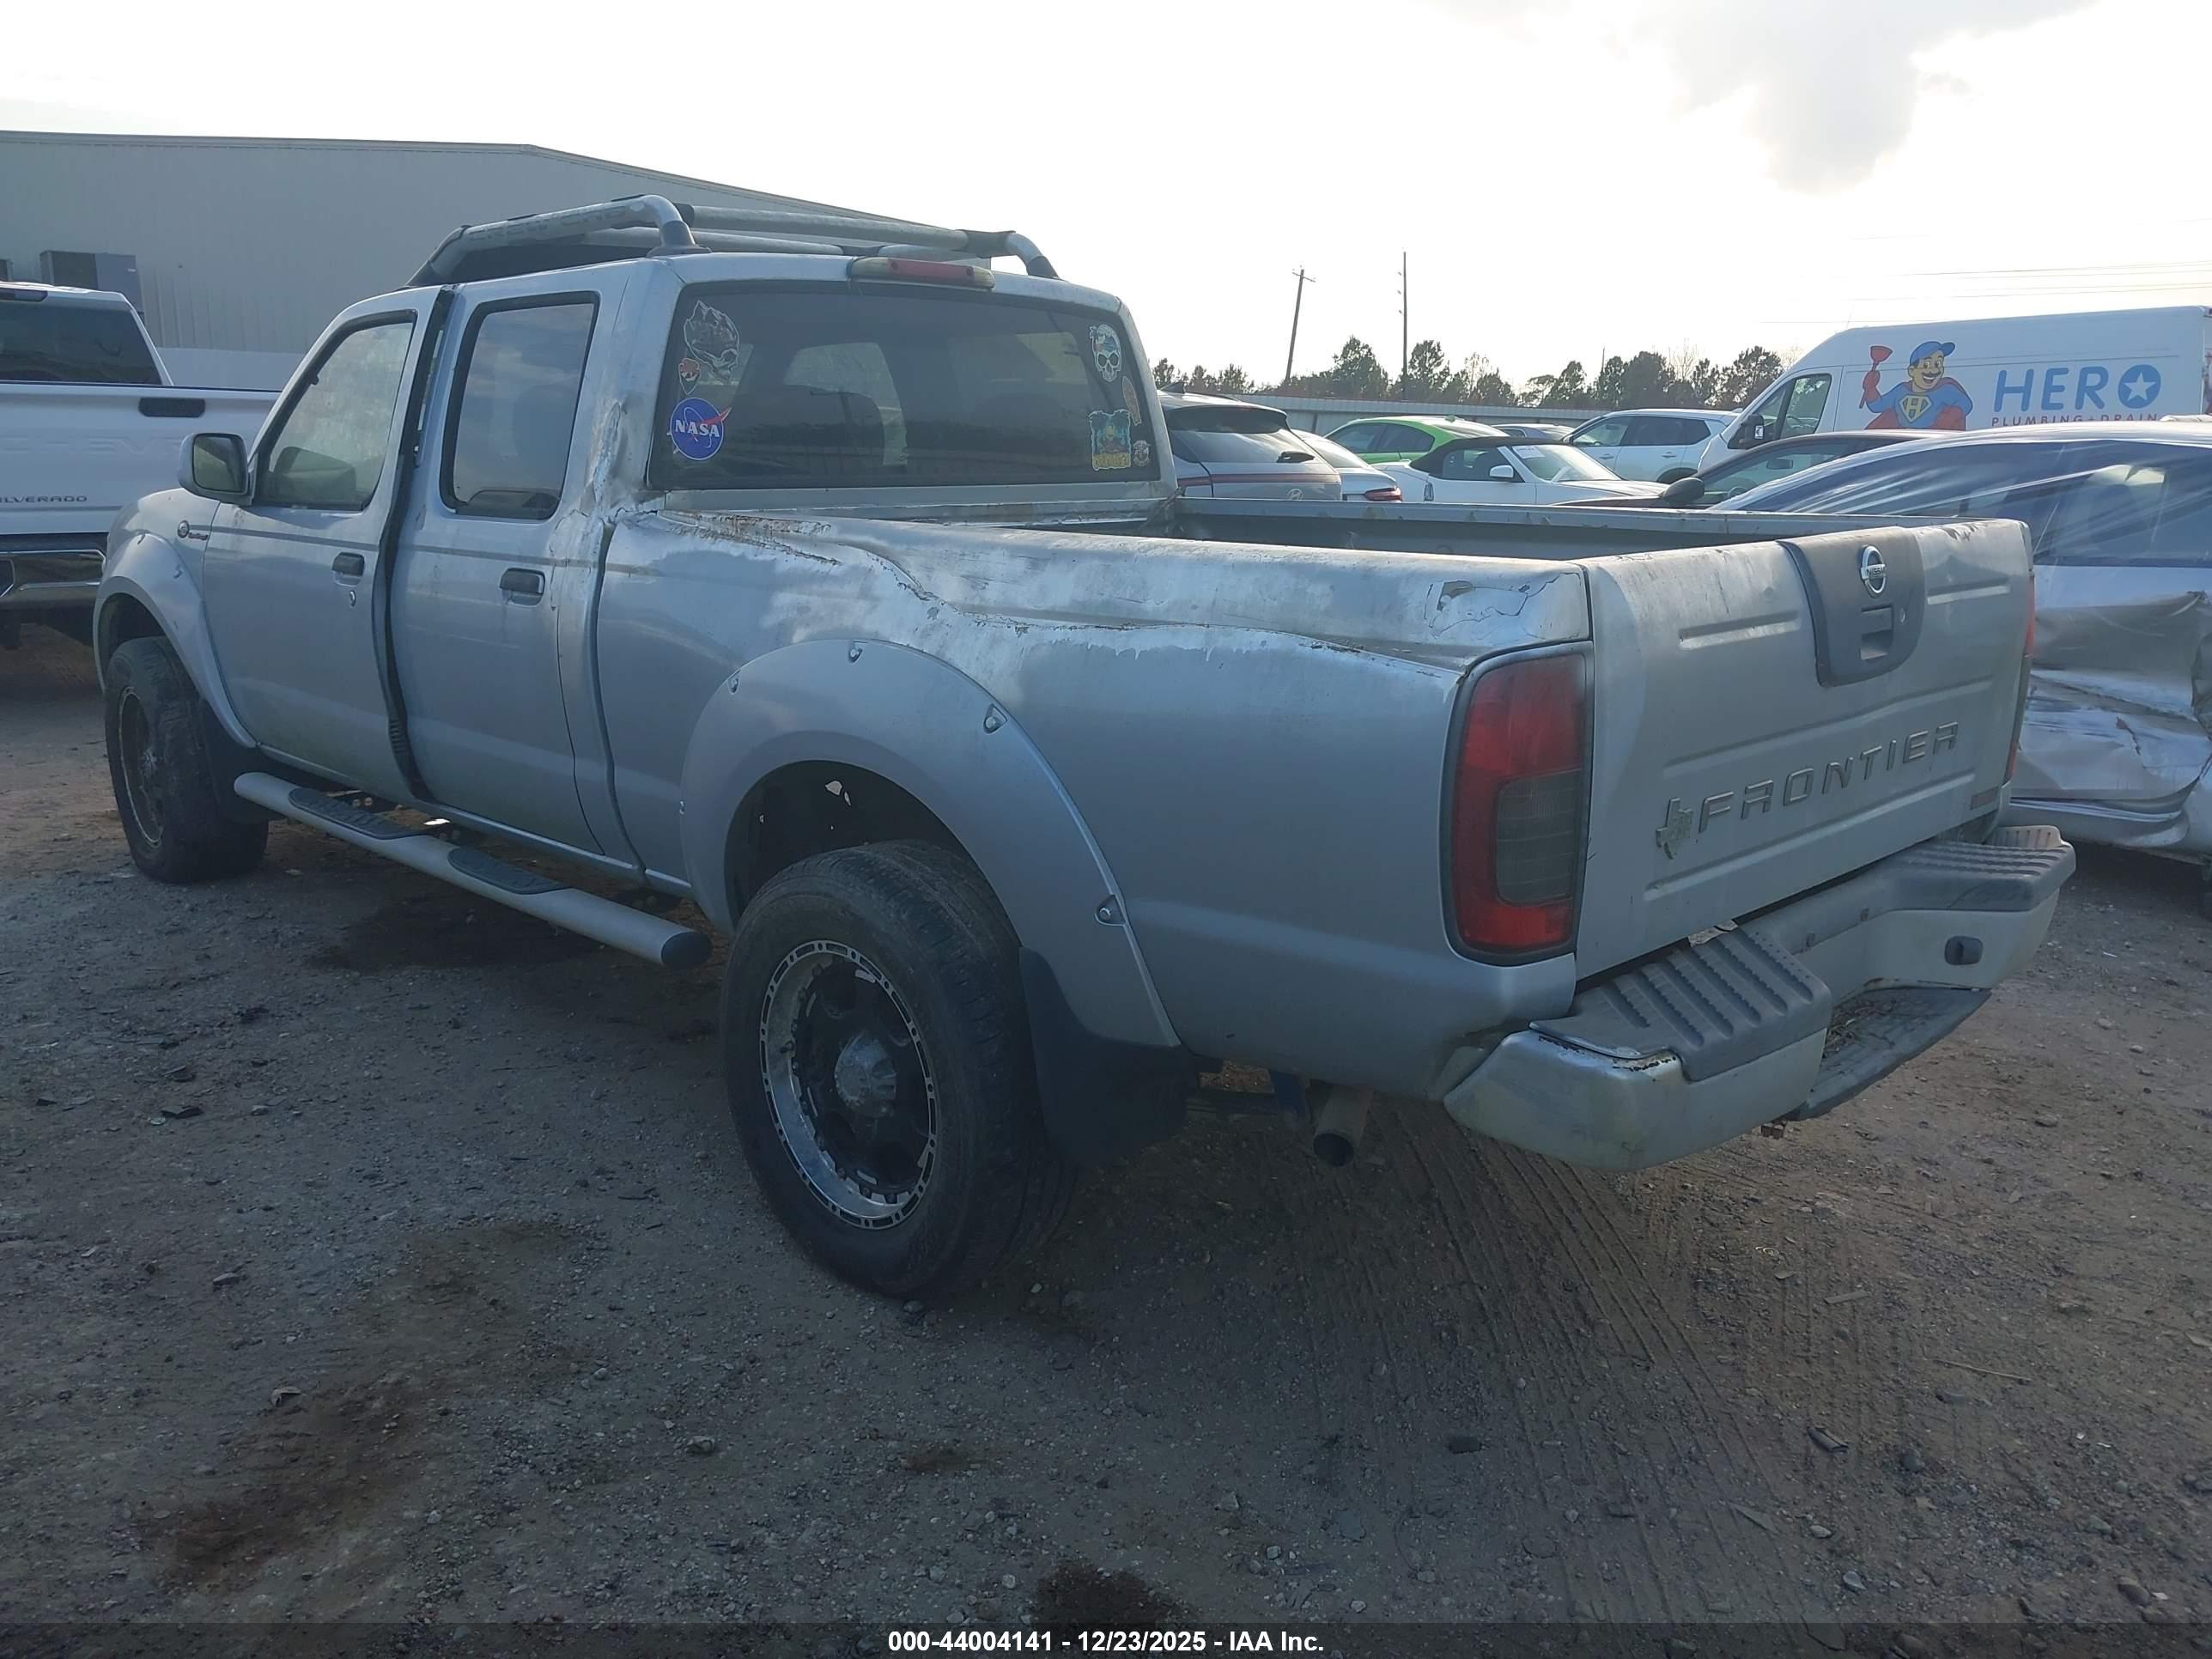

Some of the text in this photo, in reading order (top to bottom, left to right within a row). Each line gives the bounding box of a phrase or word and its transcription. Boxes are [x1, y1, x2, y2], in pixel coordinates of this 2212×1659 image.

[1994, 364, 2161, 412] HERO
[675, 419, 720, 437] NASA
[1698, 721, 1959, 833] FRONTIER
